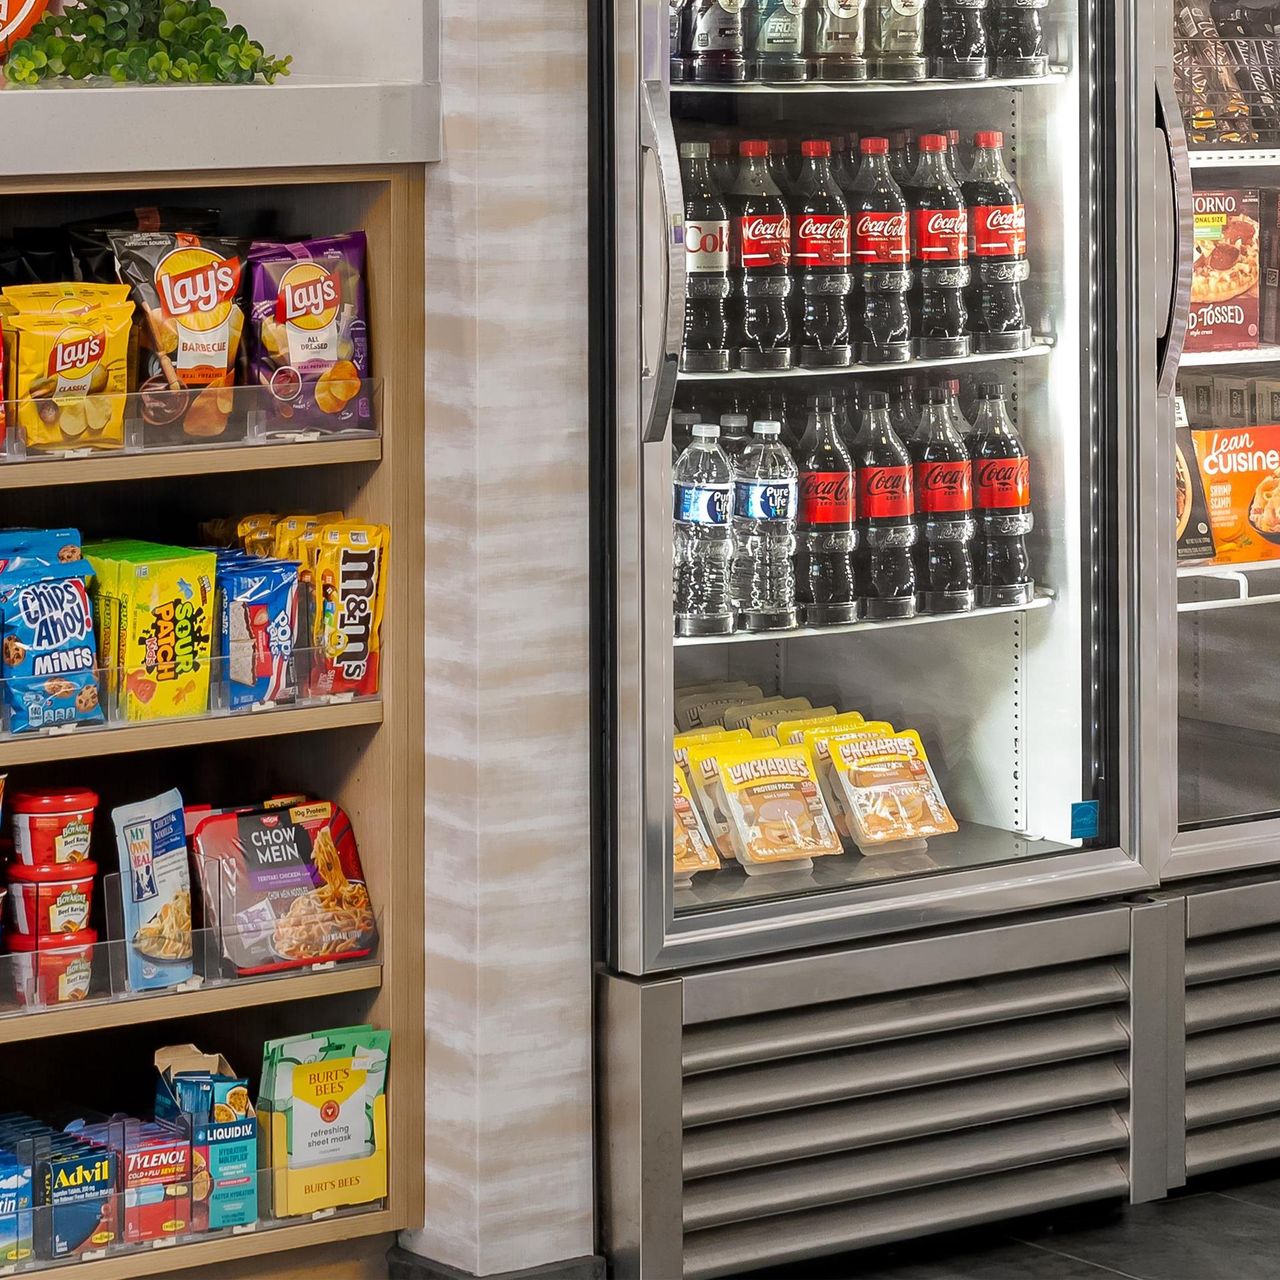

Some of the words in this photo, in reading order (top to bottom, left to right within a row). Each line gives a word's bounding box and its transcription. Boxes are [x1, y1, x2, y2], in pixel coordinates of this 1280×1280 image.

[1191, 196, 1236, 213] IORNO
[686, 225, 729, 254] Cok
[161, 261, 234, 316] Lay's
[285, 275, 336, 320] Lay's
[1189, 305, 1244, 330] D-TOSSED
[56, 334, 100, 372] Lay's
[181, 341, 227, 352] BARBECUE
[58, 384, 88, 393] CLASSIC
[1212, 432, 1254, 456] Lean
[766, 487, 789, 498] Pure
[769, 497, 787, 512] Life
[21, 583, 77, 625] Chips
[154, 602, 176, 681] PATCH
[175, 602, 194, 673] SOUR
[839, 737, 918, 764] LUNCHABLES
[729, 758, 810, 785] LUNCHABLES
[752, 784, 778, 794] PROTEIN
[778, 783, 796, 791] PACK
[305, 807, 327, 816] Protein
[130, 827, 145, 841] MY
[251, 826, 296, 847] CHOW
[64, 839, 76, 847] Beef
[130, 840, 151, 855] OWN
[132, 853, 152, 869] MEAL
[256, 843, 300, 864] MEIN
[58, 908, 70, 916] Beef
[67, 976, 78, 985] Beef
[308, 1067, 351, 1086] BURT'S
[314, 1082, 344, 1097] BEES
[207, 1126, 242, 1141] LIQUID
[310, 1123, 350, 1139] refreshing
[307, 1136, 330, 1149] sheet
[330, 1133, 352, 1144] mask
[127, 1149, 186, 1172] TYLENOL
[54, 1159, 109, 1189] Advil
[128, 1171, 145, 1180] COLD
[304, 1179, 336, 1195] BURT'S
[338, 1175, 361, 1188] BEES
